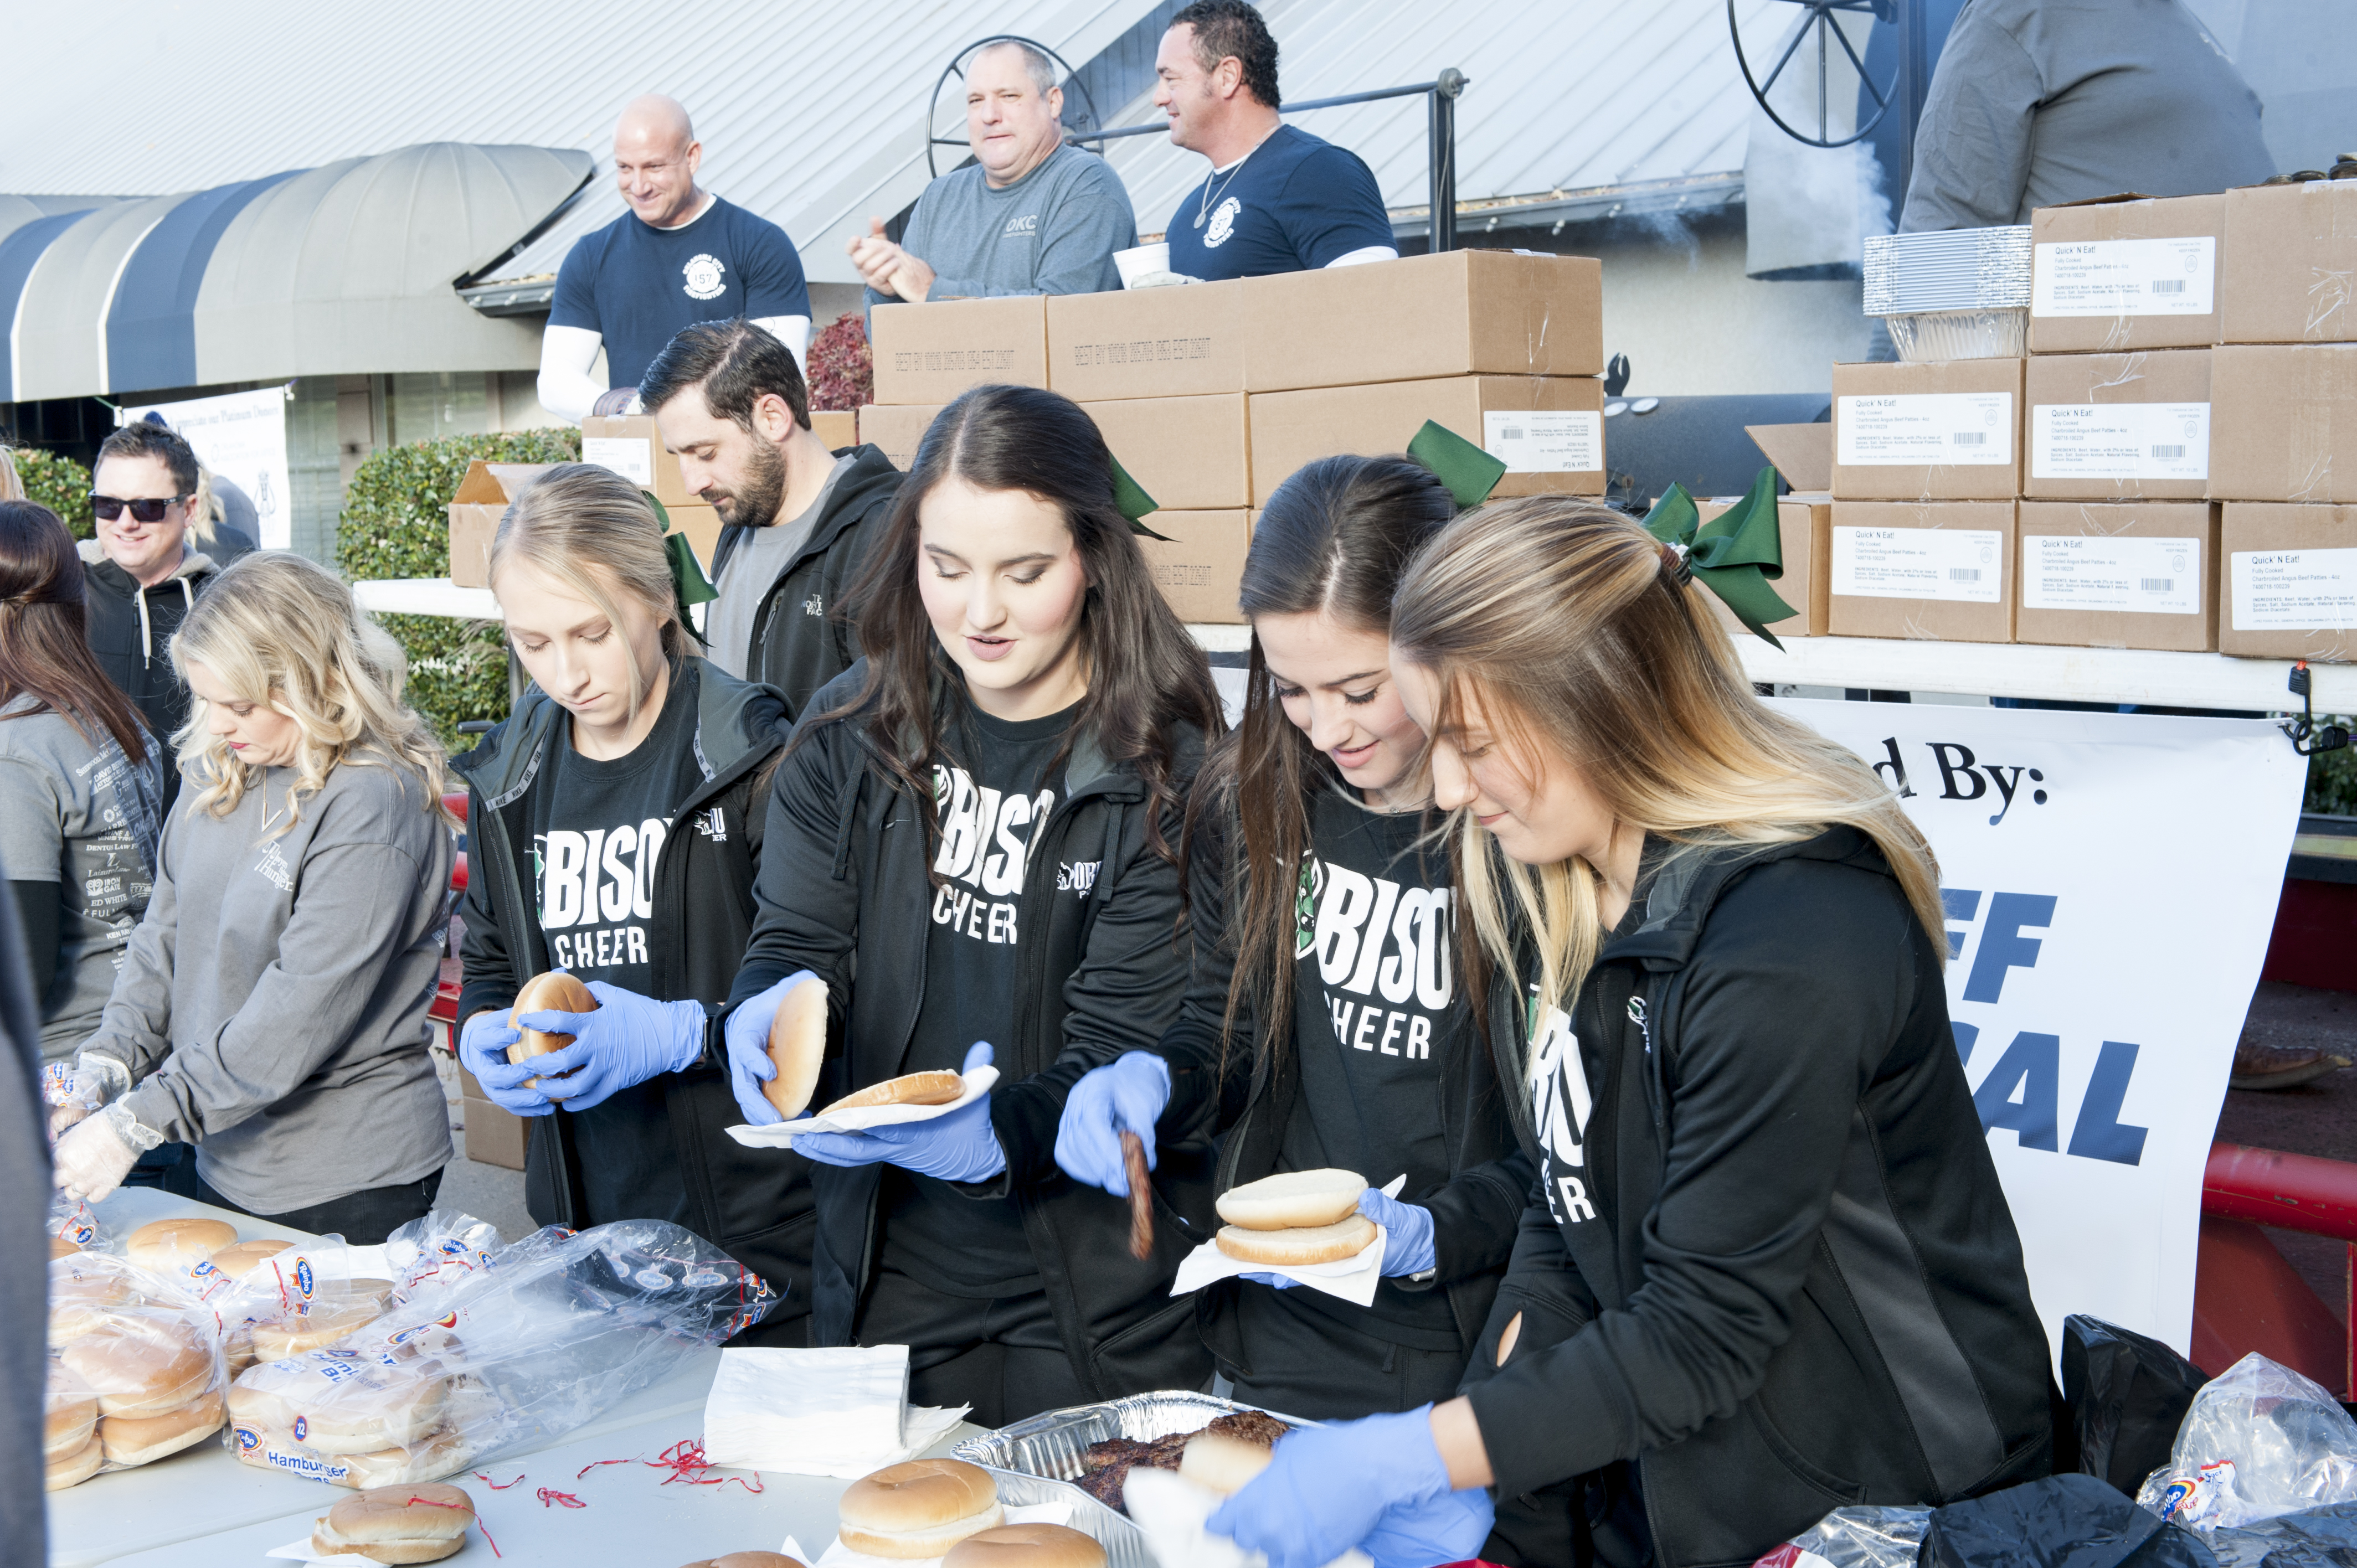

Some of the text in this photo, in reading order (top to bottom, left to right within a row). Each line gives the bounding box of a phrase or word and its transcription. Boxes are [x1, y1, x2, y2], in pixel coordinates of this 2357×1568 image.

[1006, 214, 1038, 233] OKC
[2055, 246, 2075, 255] Quick'
[695, 274, 712, 284] 157
[801, 600, 822, 610] NORT
[807, 607, 822, 616] FAC
[94, 766, 112, 782] DAVID
[523, 769, 533, 784] NIKE
[1926, 741, 2048, 826] By:
[512, 787, 523, 798] NIKE
[495, 796, 507, 806] NIKE
[545, 817, 676, 929] BISO
[104, 876, 121, 886] IRON
[104, 883, 121, 893] GATE
[104, 893, 127, 905] WHITE
[933, 884, 1017, 945] CHEER
[106, 930, 121, 940] KEN
[1318, 862, 1457, 1010] BISO
[554, 926, 649, 969] CHEER
[299, 1263, 310, 1292] Rainbo
[297, 1422, 305, 1436] 12
[269, 1451, 347, 1478] Hamburger
